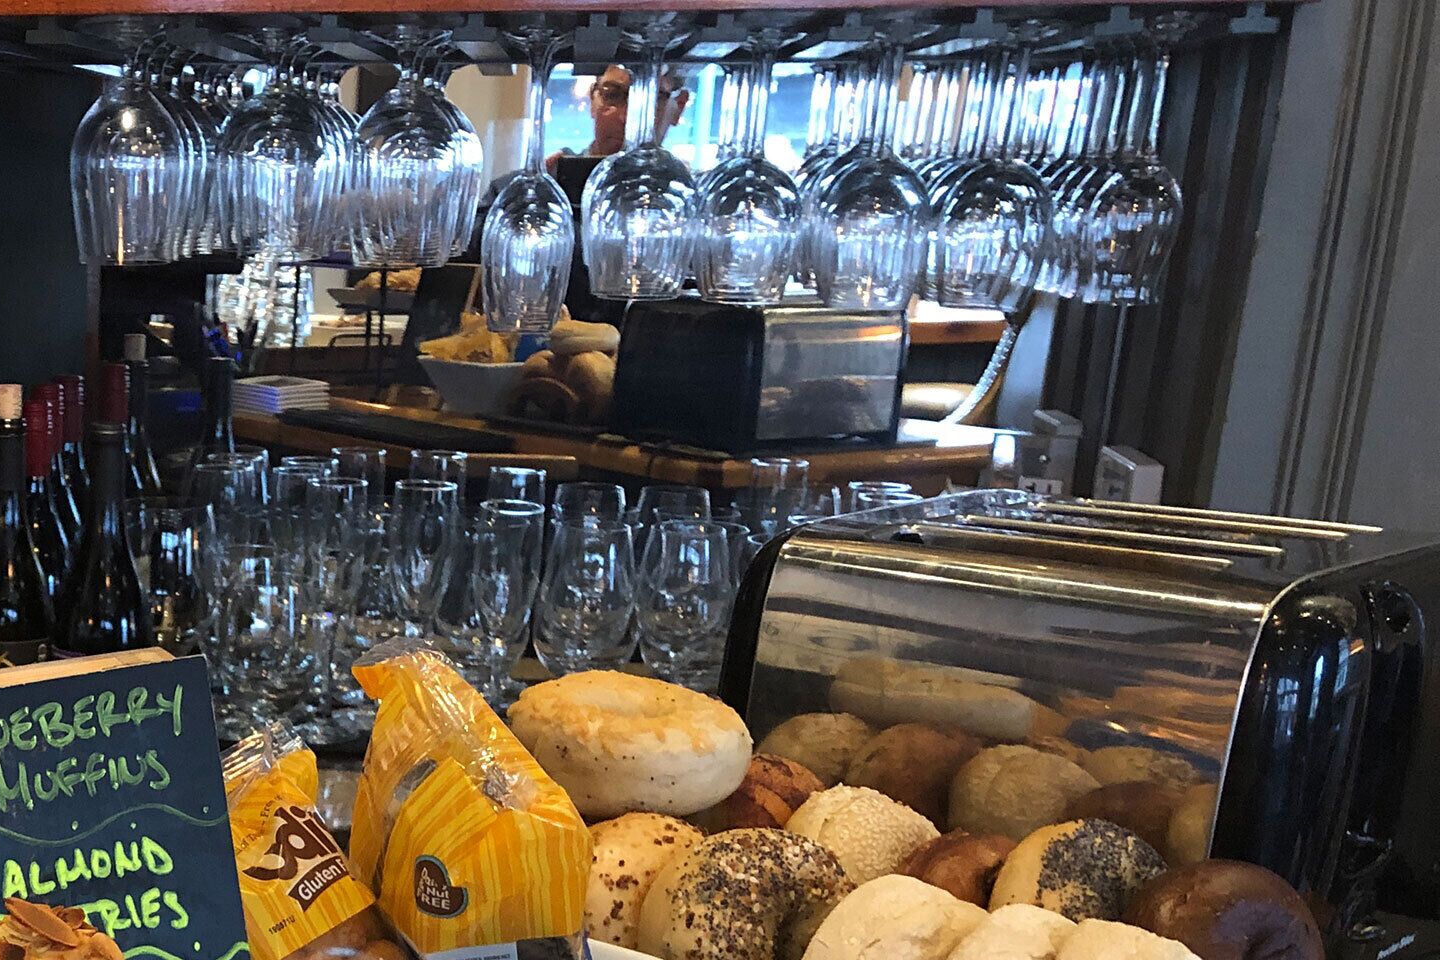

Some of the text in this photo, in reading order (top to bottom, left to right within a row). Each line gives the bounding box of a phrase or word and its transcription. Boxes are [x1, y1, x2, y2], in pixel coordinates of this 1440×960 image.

[2, 835, 174, 900] ALMOND
[298, 863, 342, 901] Gluten
[417, 887, 451, 910] FREE
[426, 887, 450, 899] Nut
